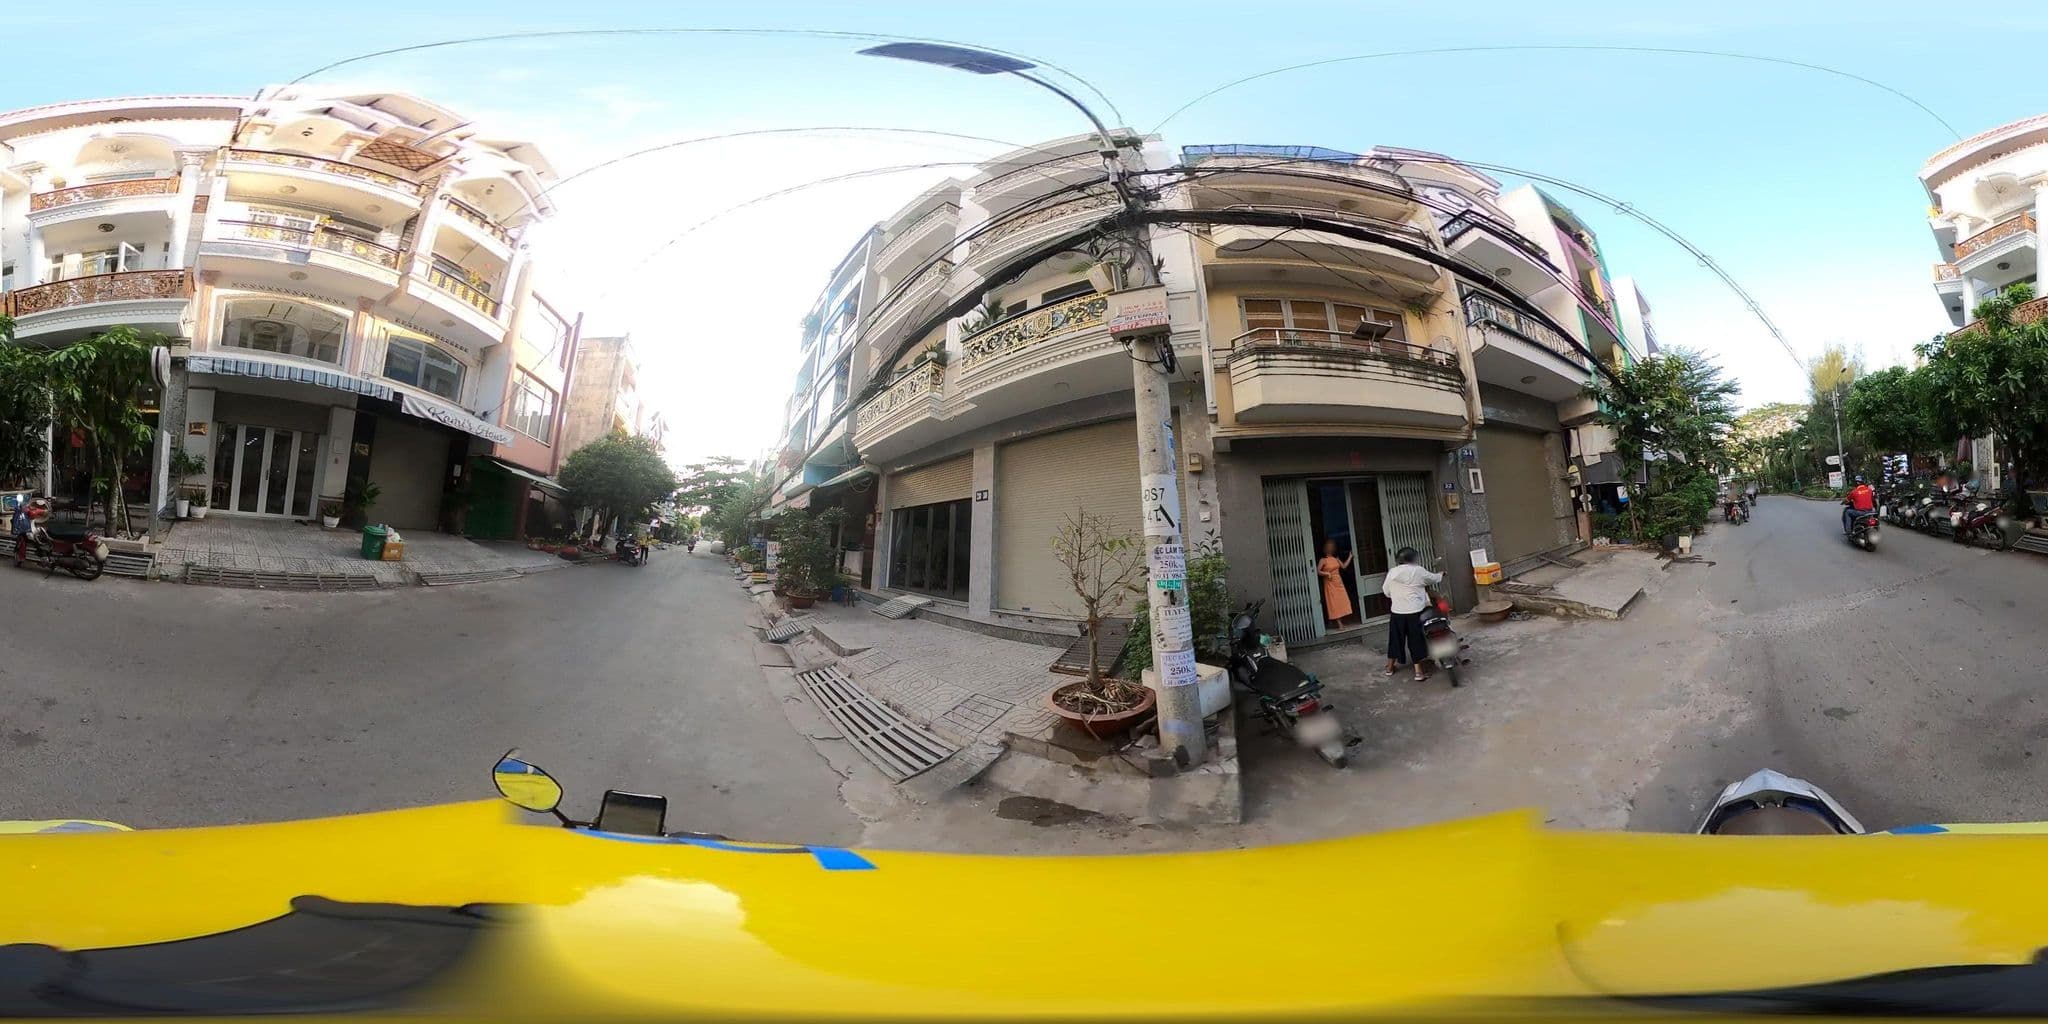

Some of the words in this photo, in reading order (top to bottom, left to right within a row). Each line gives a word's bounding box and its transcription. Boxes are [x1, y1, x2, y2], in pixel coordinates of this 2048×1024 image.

[427, 406, 473, 431] Kami's
[475, 424, 507, 441] House
[1170, 664, 1191, 676] 250k
